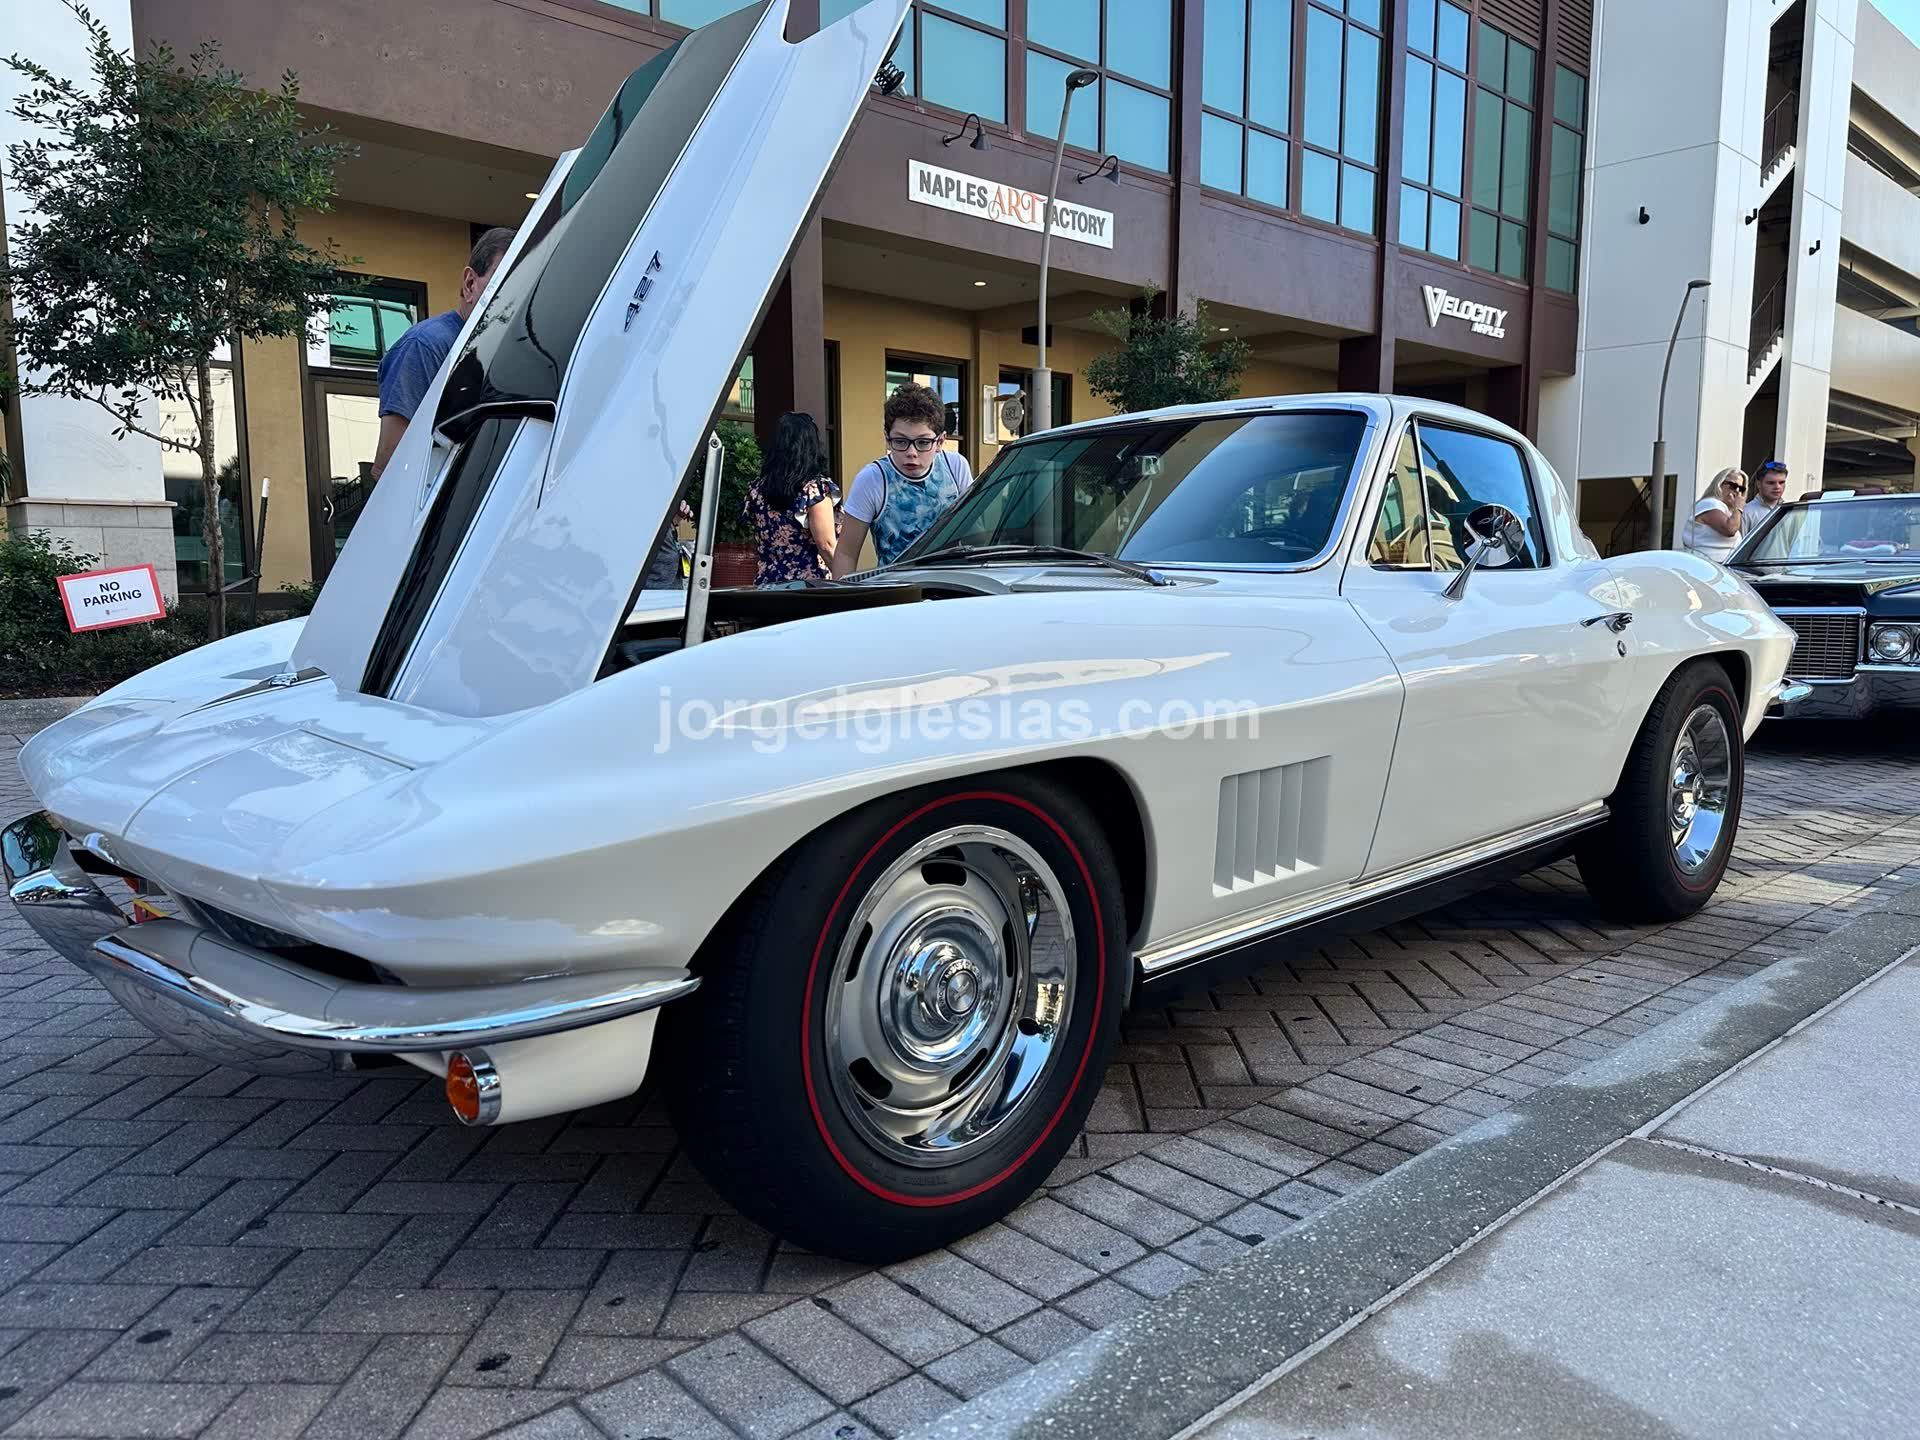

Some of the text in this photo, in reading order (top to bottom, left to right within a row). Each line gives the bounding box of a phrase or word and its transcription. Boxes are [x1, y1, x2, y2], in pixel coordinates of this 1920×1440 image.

[919, 169, 988, 209] NAPLES
[988, 185, 1048, 224] ART
[624, 250, 662, 332] 427
[1423, 285, 1508, 328] VELOCITY
[1471, 322, 1506, 339] NAPLES
[83, 589, 142, 607] PARKING
[99, 581, 120, 593] NO
